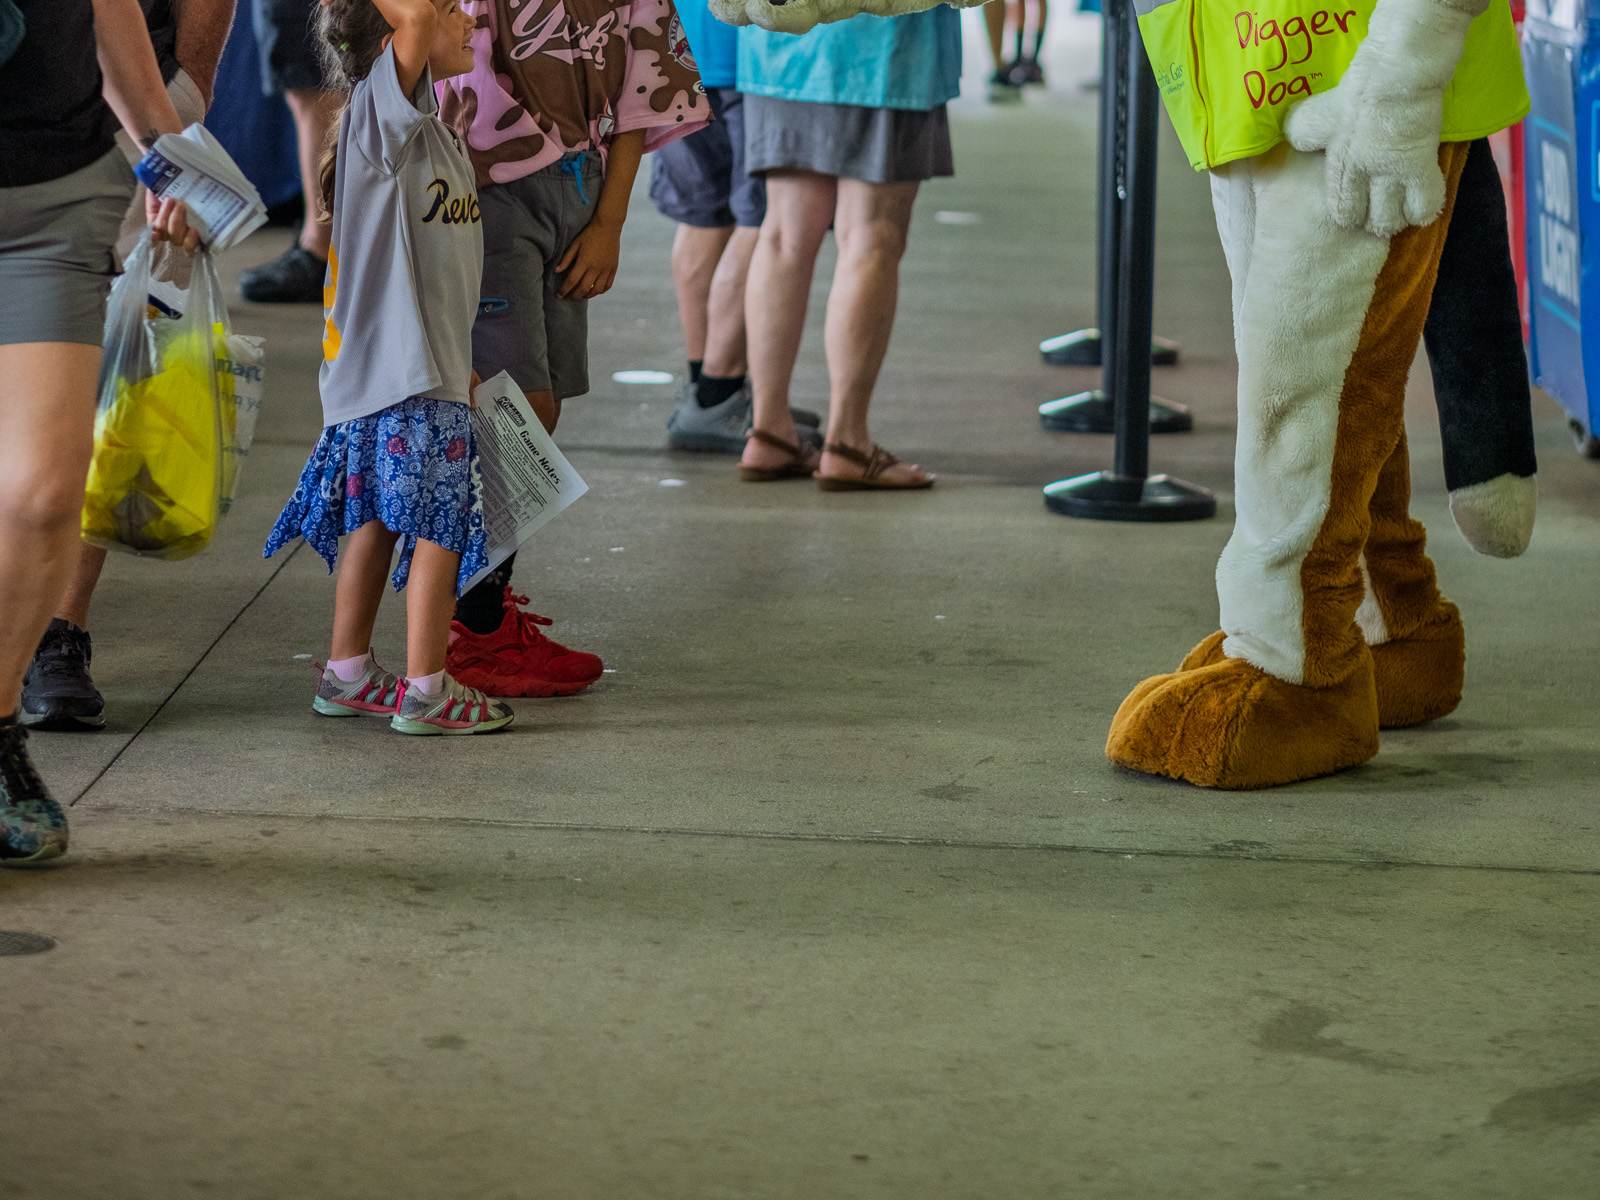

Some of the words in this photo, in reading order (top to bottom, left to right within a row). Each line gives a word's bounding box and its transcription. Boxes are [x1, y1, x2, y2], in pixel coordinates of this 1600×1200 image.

[1234, 10, 1357, 72] Digger
[520, 431, 540, 457] Game
[538, 457, 561, 485] Notes
